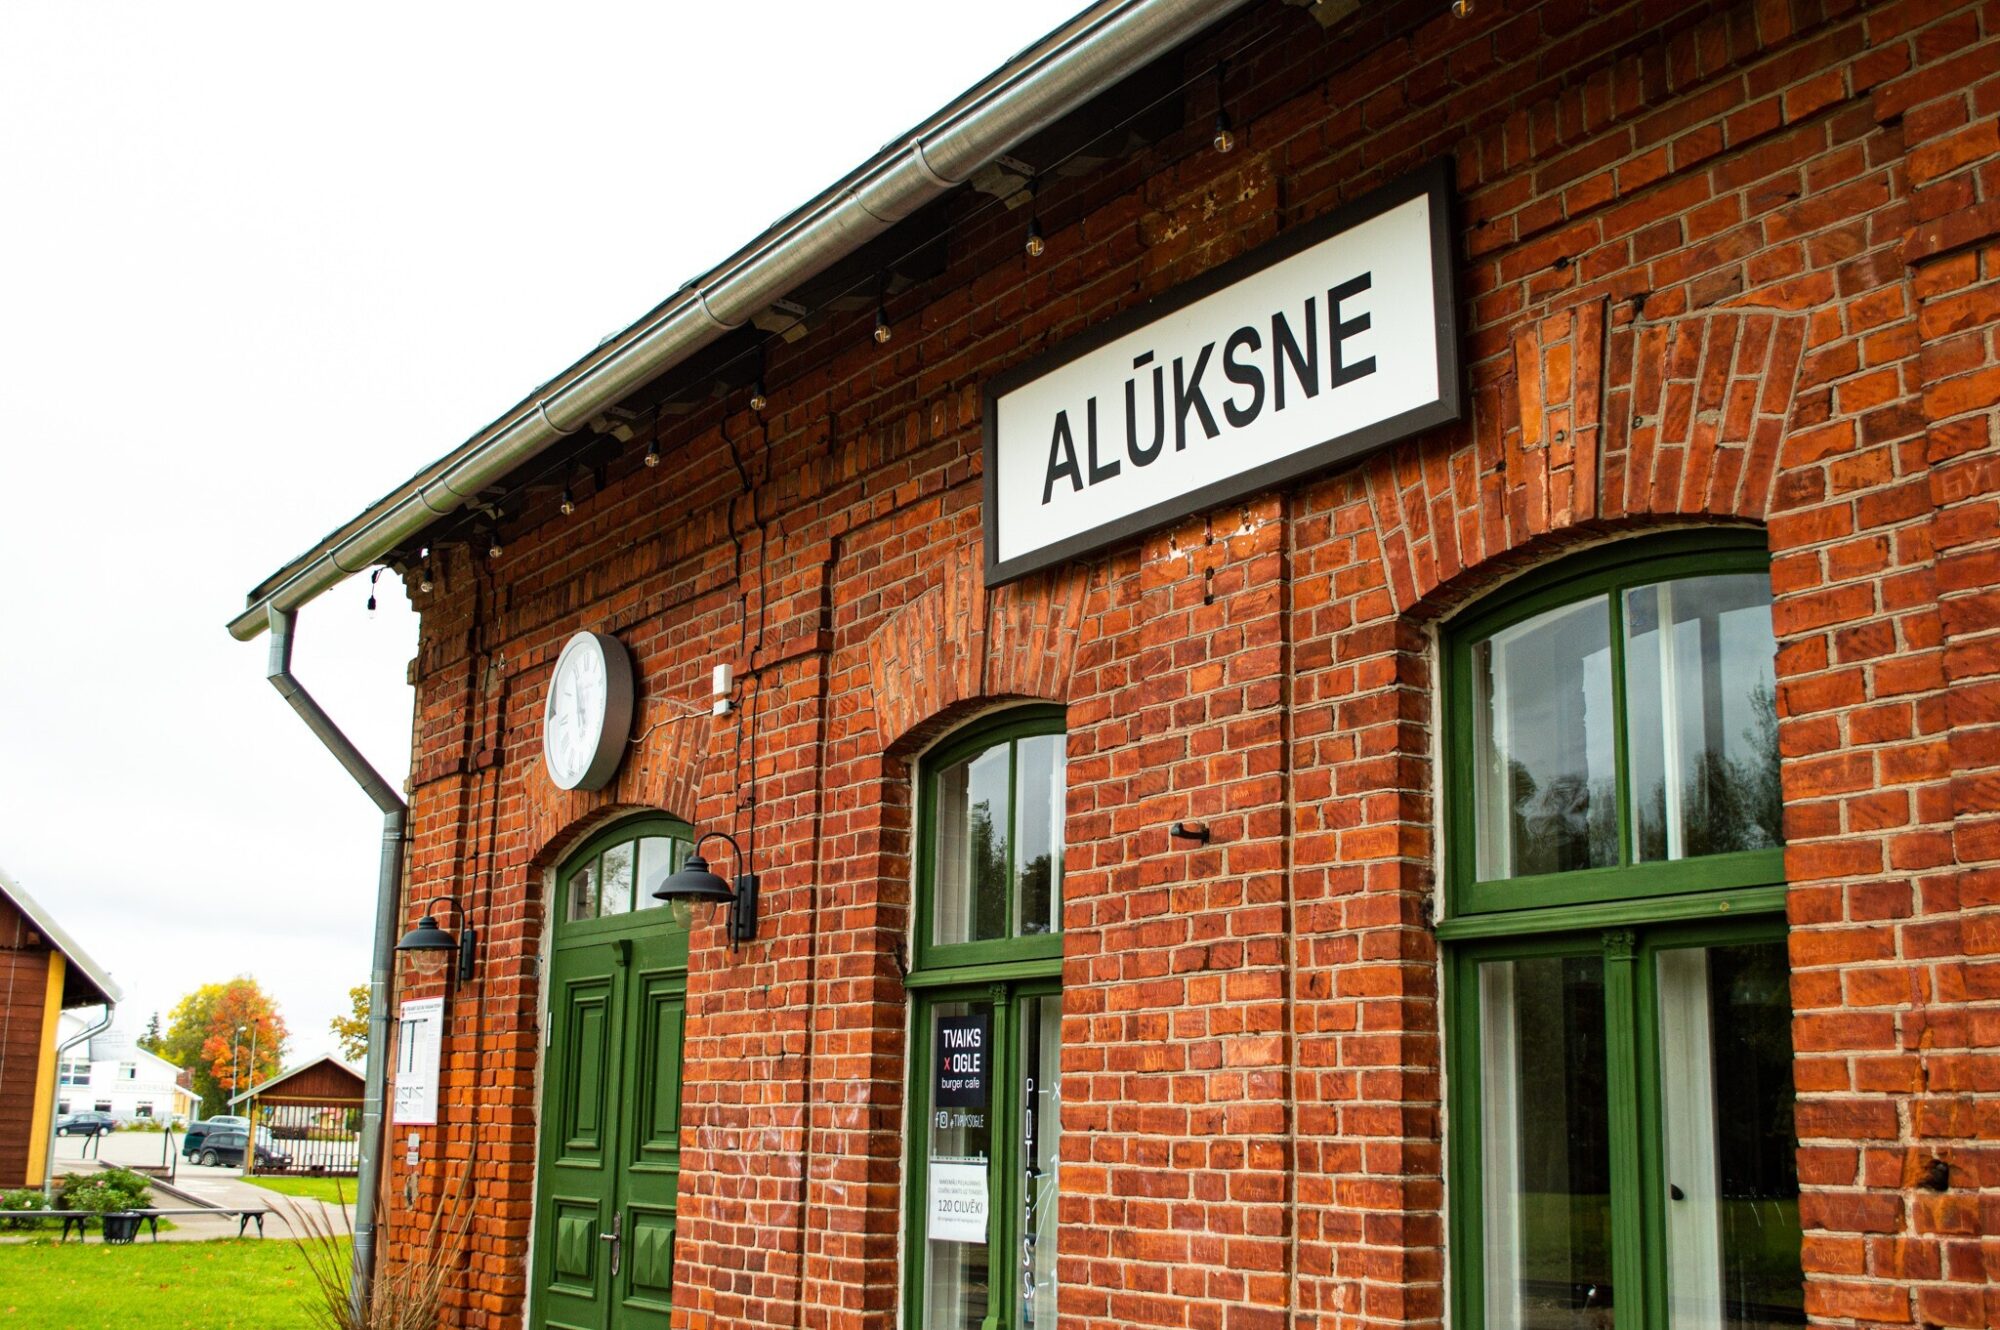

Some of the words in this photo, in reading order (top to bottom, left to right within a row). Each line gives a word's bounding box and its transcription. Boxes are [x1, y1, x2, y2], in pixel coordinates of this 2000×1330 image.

[1041, 270, 1377, 505] ALŪKSNE
[943, 1028, 981, 1048] TVAIKS
[953, 1053, 981, 1073] OGLE
[941, 1077, 963, 1091] burger
[964, 1077, 980, 1089] cafe
[938, 1199, 953, 1212] 120
[954, 1199, 983, 1214] CILVĒKI
